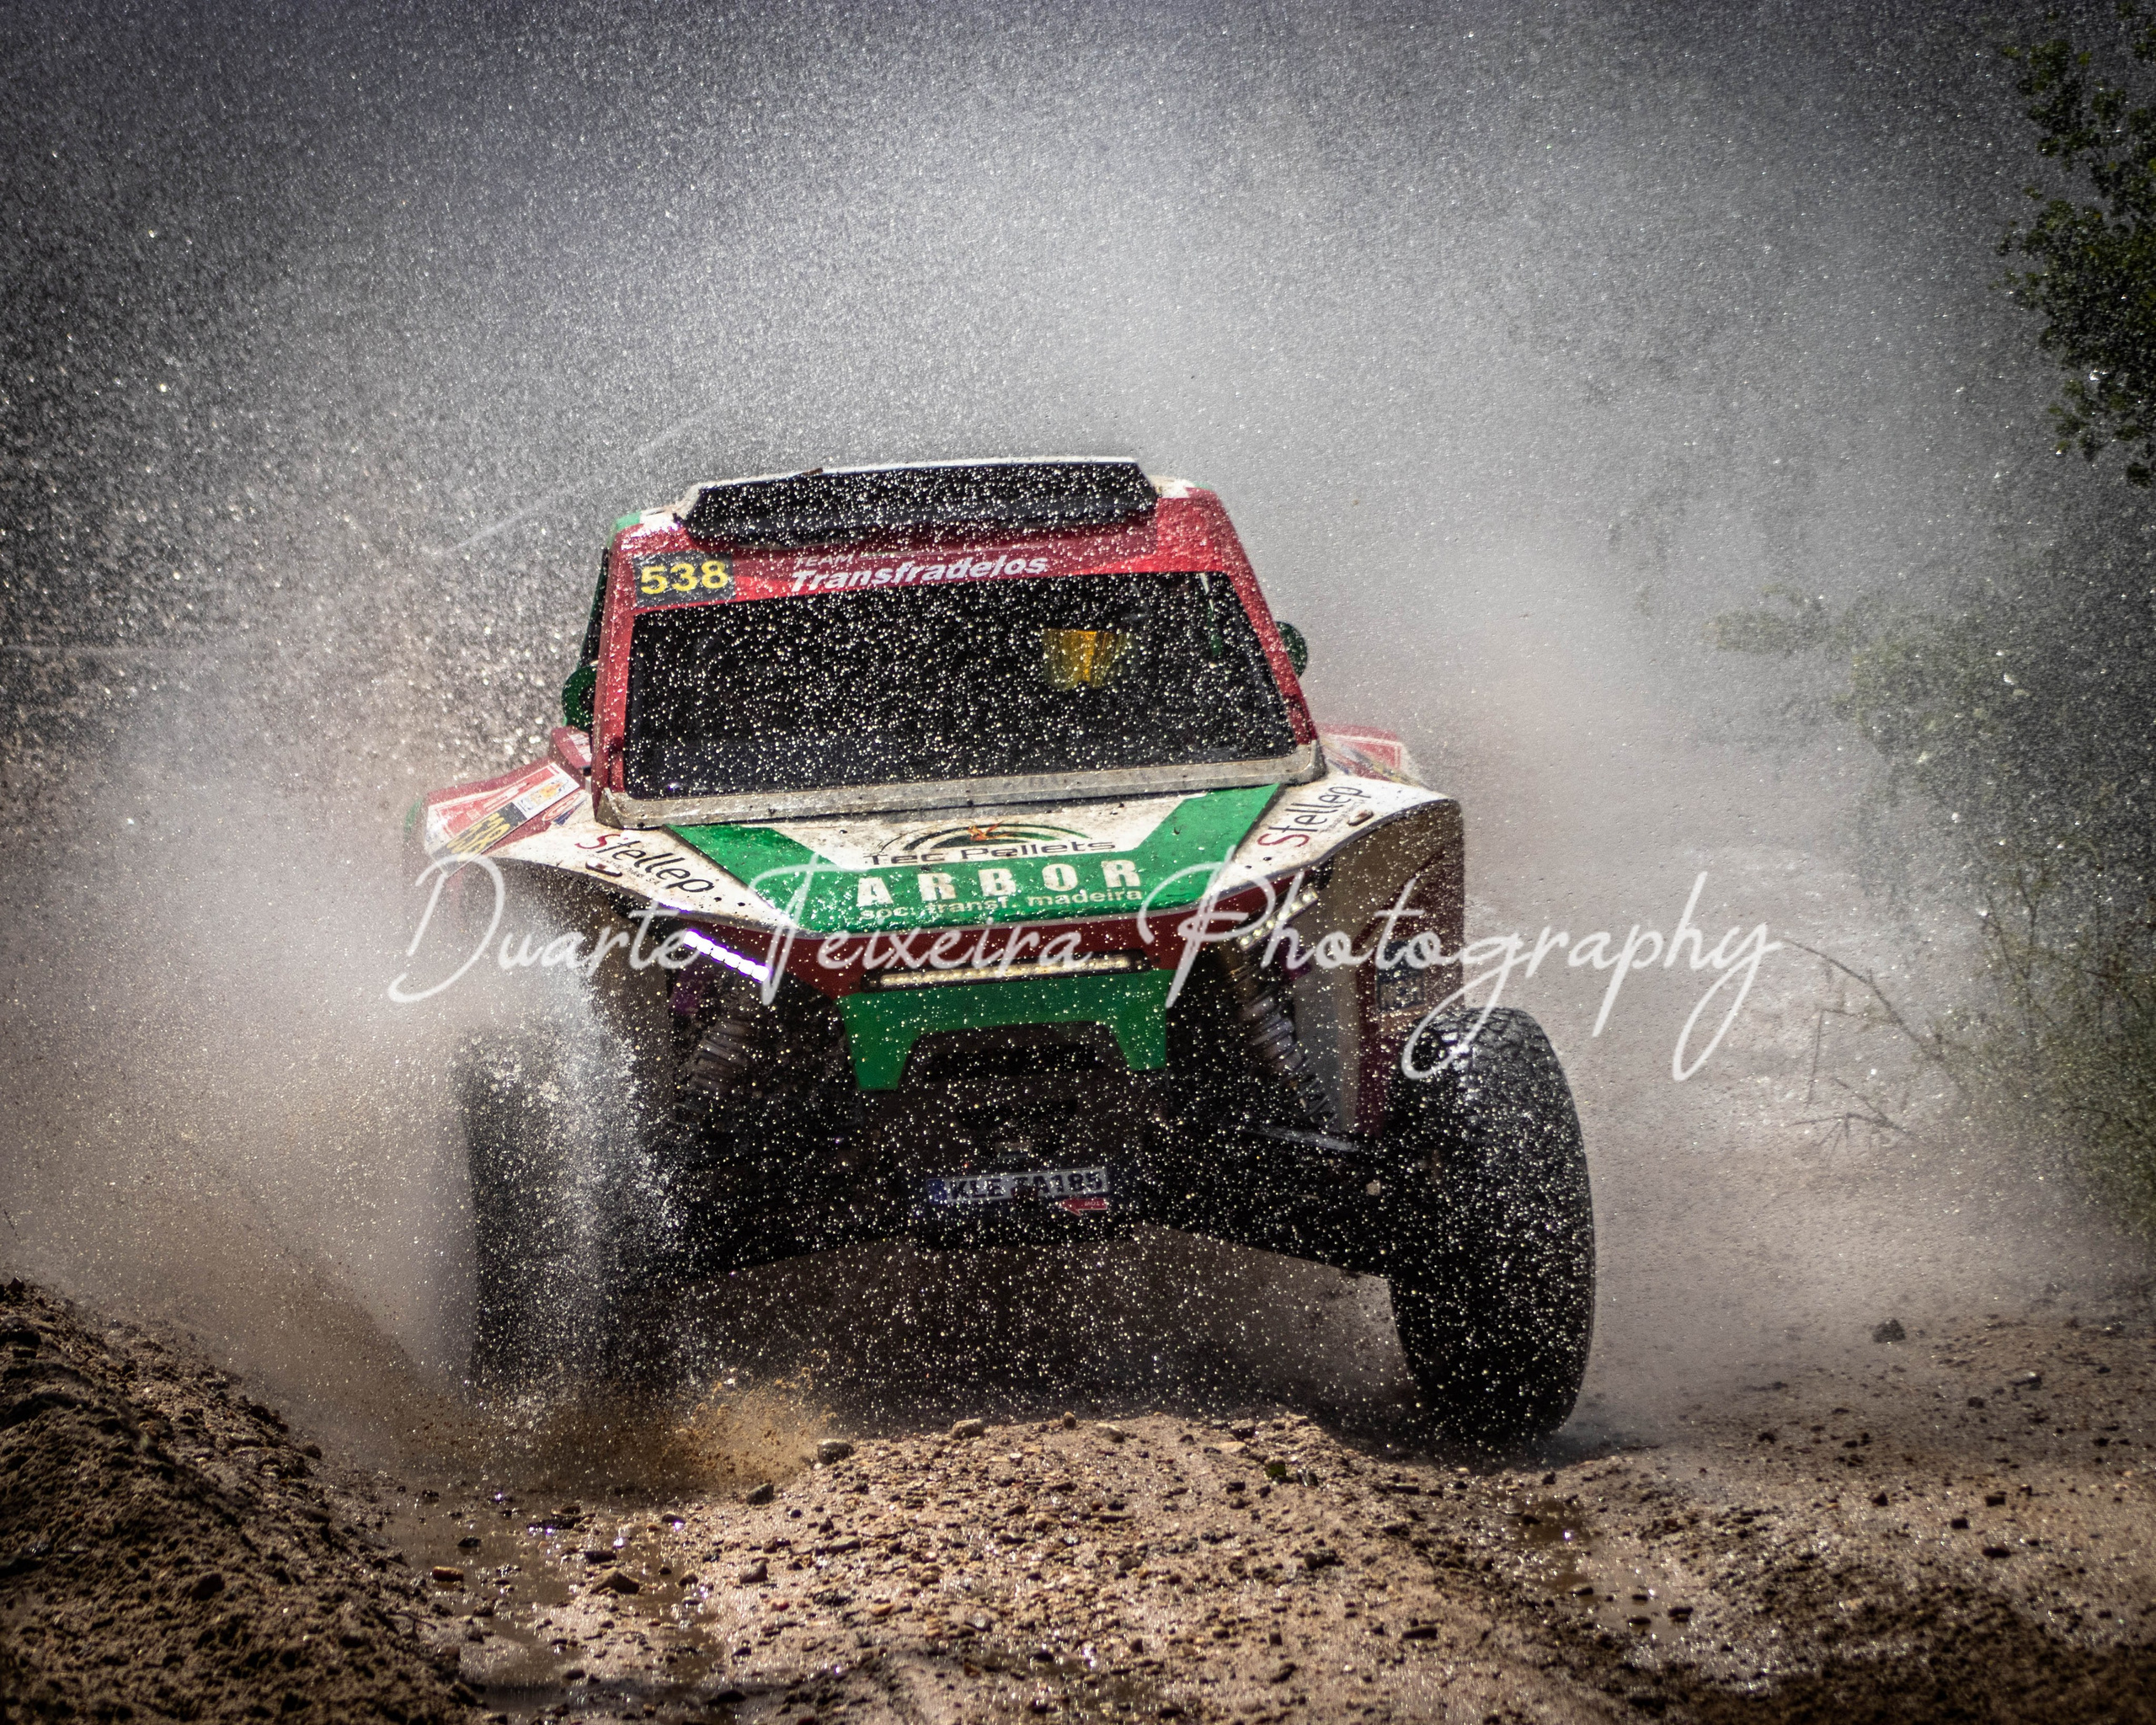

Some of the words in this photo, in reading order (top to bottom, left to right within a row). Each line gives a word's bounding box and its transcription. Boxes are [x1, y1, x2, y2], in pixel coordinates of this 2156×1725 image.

[640, 559, 728, 595] 538
[791, 553, 1048, 592] Transfradelos
[794, 553, 855, 569] TEAM
[1257, 786, 1372, 847] Stellep
[574, 833, 715, 893] Stellep
[863, 852, 945, 866] Tec
[961, 840, 1117, 860] Pellets
[856, 859, 1141, 907] ARBOR
[1027, 889, 1143, 907] madeira
